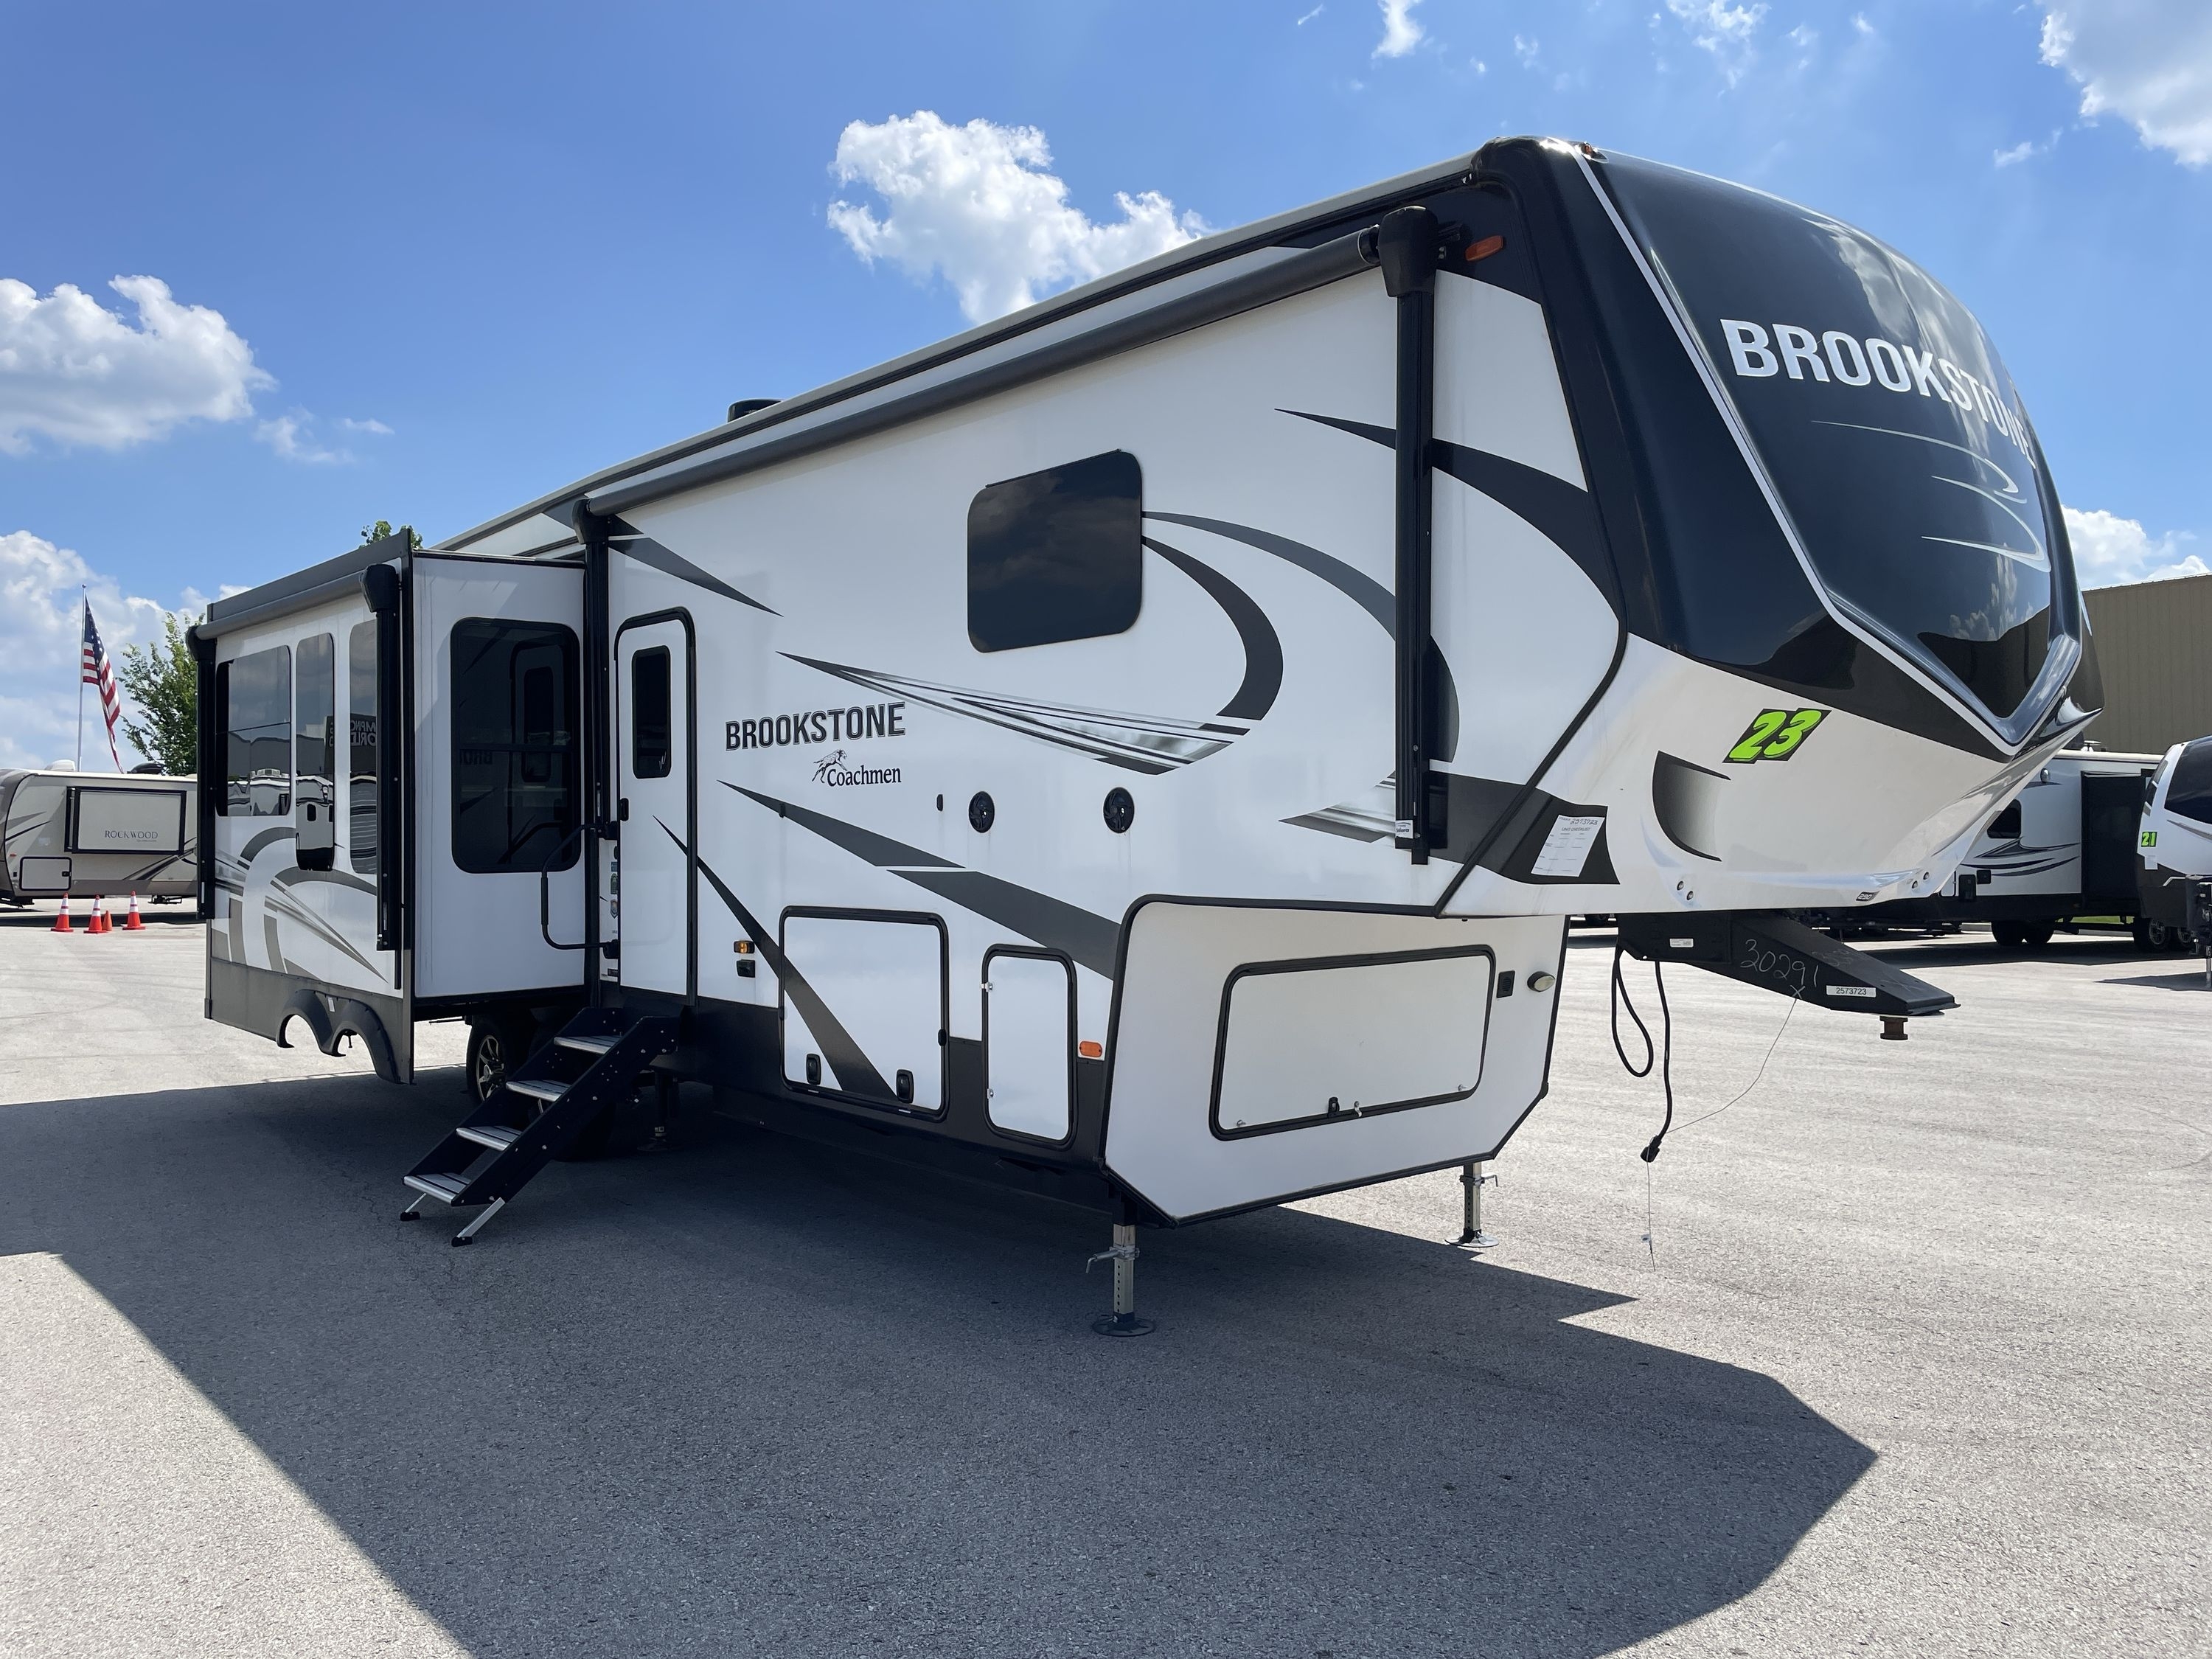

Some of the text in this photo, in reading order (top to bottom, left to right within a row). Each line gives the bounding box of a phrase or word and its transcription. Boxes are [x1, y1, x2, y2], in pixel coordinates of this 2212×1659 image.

[1719, 319, 2037, 470] BROOKSTONE
[726, 701, 906, 751] BROOKSTONE
[1728, 709, 1823, 762] 23
[827, 765, 902, 787] Coachmen
[1570, 818, 1599, 826] 2573723
[105, 830, 159, 839] ROCKWOOD
[2141, 832, 2157, 846] 21
[1740, 939, 1819, 988] 30291
[1835, 987, 1867, 995] 2573723
